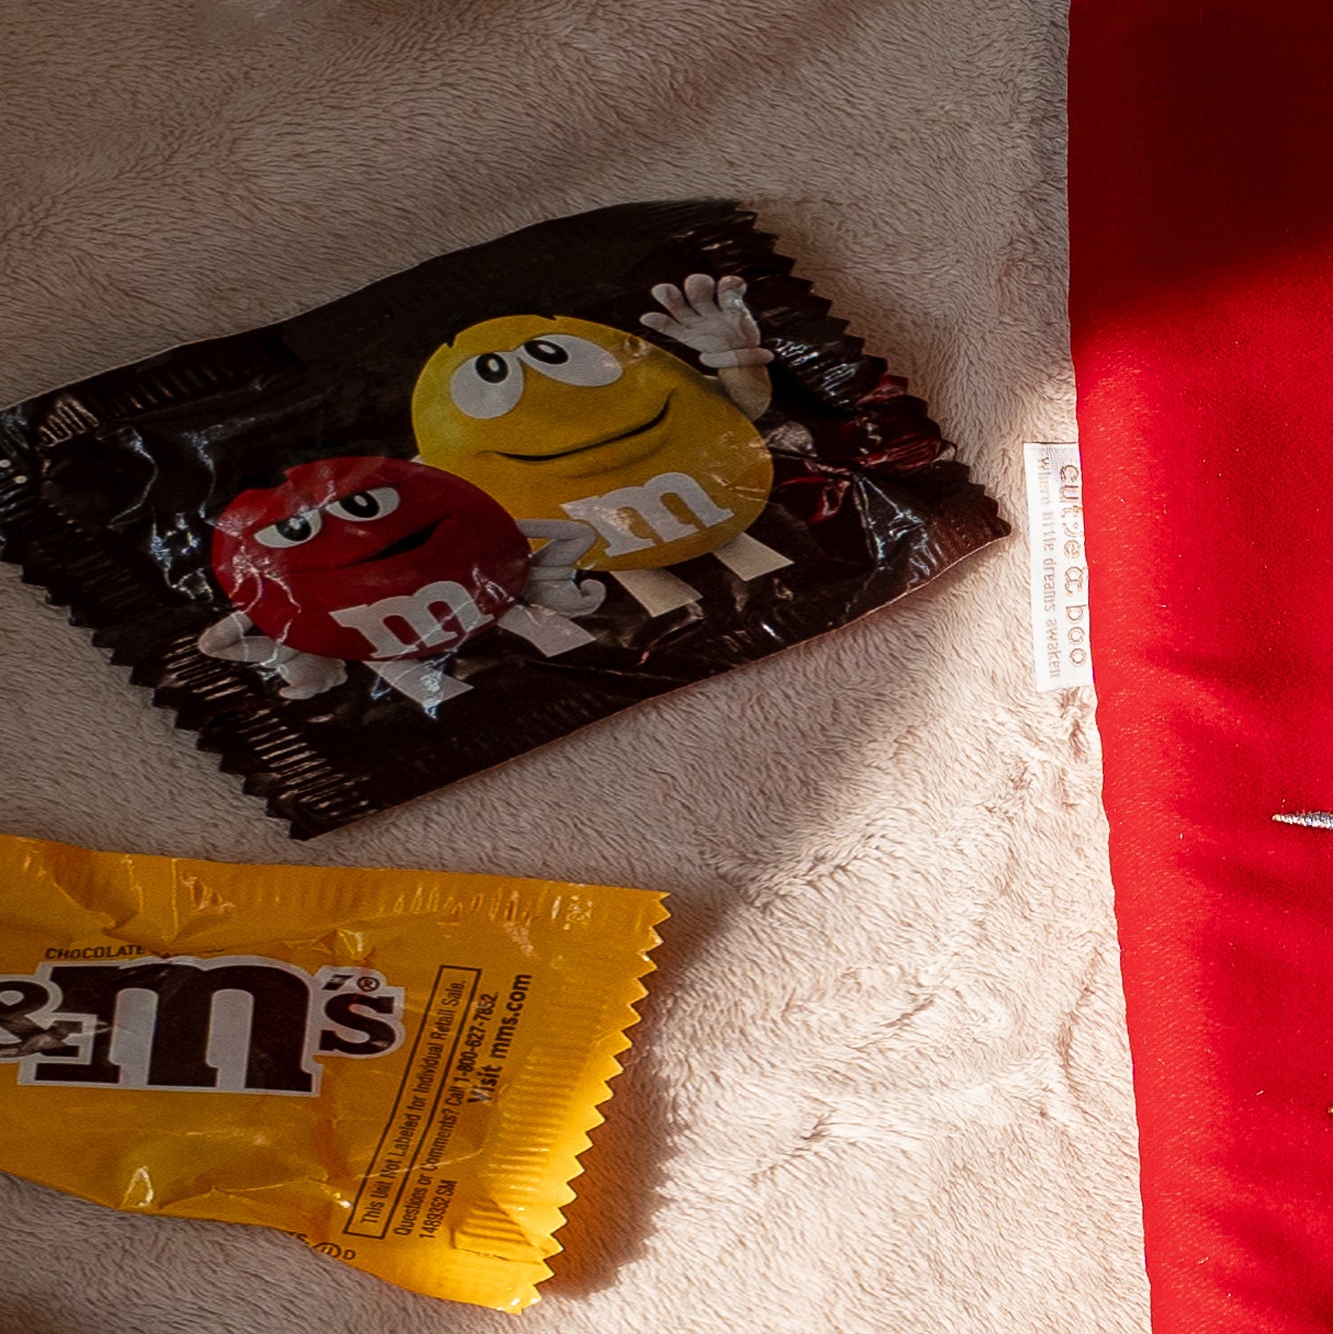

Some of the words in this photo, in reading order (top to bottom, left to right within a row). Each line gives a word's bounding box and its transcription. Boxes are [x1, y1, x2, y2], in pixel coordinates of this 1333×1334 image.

[1036, 457, 1053, 505] where
[560, 472, 734, 557] m
[1043, 557, 1059, 612] dreams
[329, 581, 494, 658] m
[1065, 605, 1088, 667] boo
[1046, 618, 1063, 679] awaken
[45, 945, 145, 960] CHOCOLATE
[442, 979, 468, 1008] Sale.
[432, 1010, 457, 1041] Retail
[468, 1064, 502, 1106] Visit
[490, 973, 532, 1059] mms.com
[416, 1043, 445, 1094] Individual
[409, 1095, 427, 1112] for
[447, 1085, 469, 1107] Call
[392, 1114, 421, 1157] Labeled
[422, 1109, 460, 1173] Comments?
[371, 1181, 395, 1200] Unit
[380, 1159, 403, 1178] Not
[420, 1175, 433, 1186] or
[361, 1200, 385, 1225] This
[394, 1186, 429, 1238] Questions
